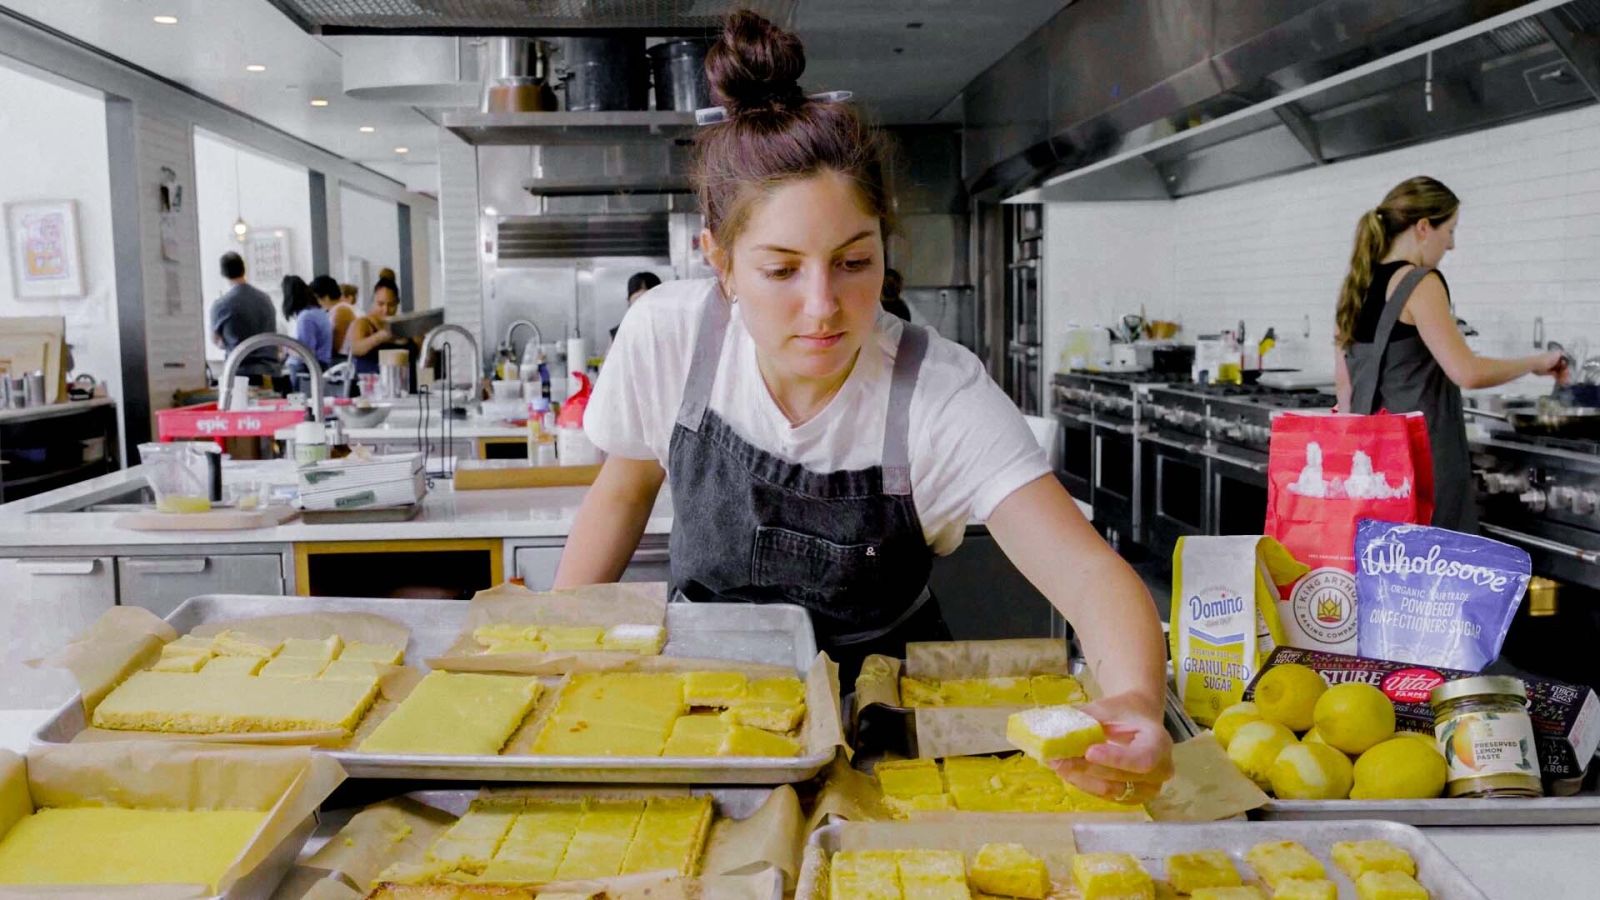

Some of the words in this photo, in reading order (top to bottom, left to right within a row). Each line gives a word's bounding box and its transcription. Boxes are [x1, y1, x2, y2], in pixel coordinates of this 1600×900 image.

[196, 415, 228, 434] epic
[237, 415, 261, 431] rio
[1361, 539, 1507, 592] Wholesome
[1300, 578, 1321, 602] KING
[1324, 576, 1357, 605] ARTHU
[1390, 584, 1426, 599] ORGANIC
[1189, 593, 1243, 621] Domino
[1400, 597, 1456, 618] POWDERED
[1300, 613, 1324, 637] BAKING
[1326, 620, 1357, 639] COMPAN
[1370, 608, 1449, 634] CONFECTIONERS
[1449, 619, 1482, 640] SUGAR
[1183, 657, 1251, 681] GRANULATED
[1318, 669, 1383, 686] STURE
[1203, 676, 1233, 692] SUGAR
[1385, 674, 1441, 691] Vital
[1551, 686, 1579, 699] ETHICAL
[1552, 692, 1573, 703] EGGS
[1474, 740, 1518, 749] PRESERVED
[1475, 747, 1503, 755] LEMON
[1476, 753, 1501, 761] PASTE
[1548, 755, 1560, 765] 12
[1543, 764, 1570, 774] ARGE
